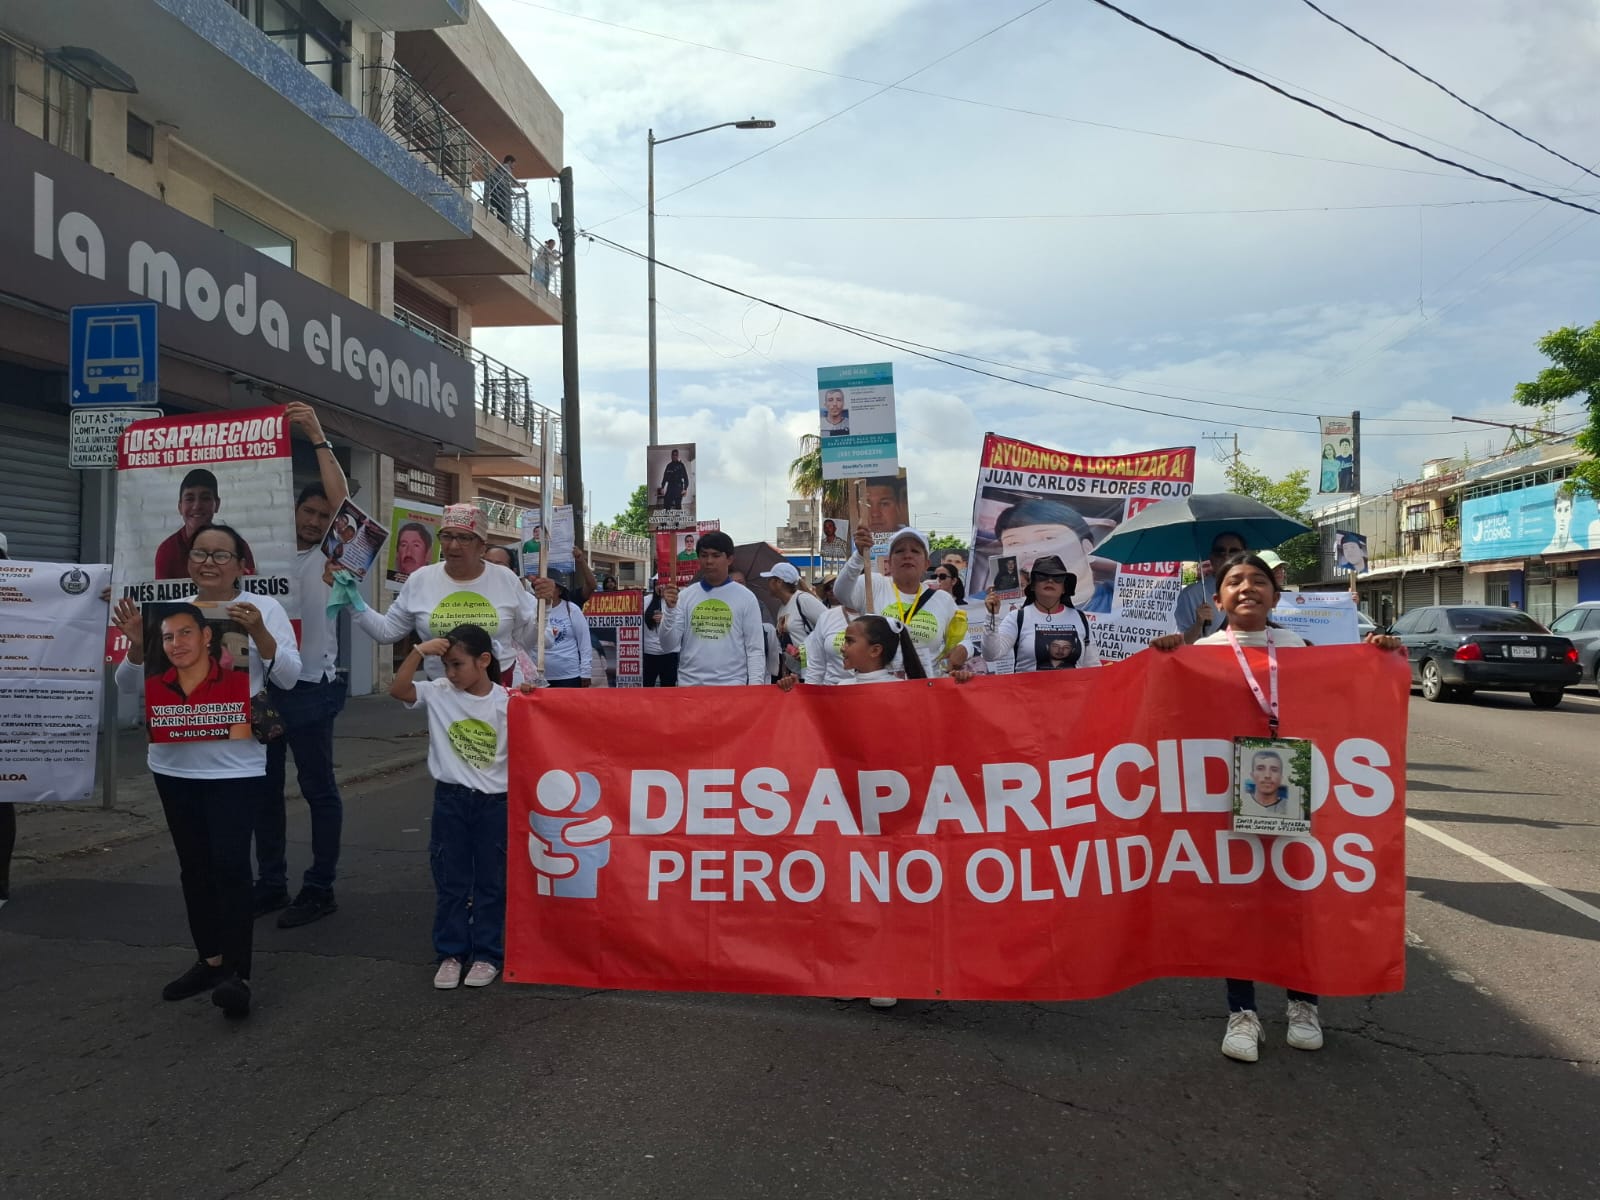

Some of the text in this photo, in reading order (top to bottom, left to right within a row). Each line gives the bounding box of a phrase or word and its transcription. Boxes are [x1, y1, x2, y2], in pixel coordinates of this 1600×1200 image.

[34, 171, 458, 418] la moda elegante
[123, 416, 283, 454] ¡DESAPARECIDO!
[128, 442, 276, 466] DESDE 16 DE ENERO DEL 2025
[990, 441, 1186, 477] ¡AYÚDANOS A LOCALIZAR A!
[985, 469, 1191, 497] JUAN CARLOS FLORES ROJO
[1483, 527, 1512, 541] COSMOS
[123, 584, 154, 601] INÉS
[1117, 577, 1125, 587] EL
[1137, 578, 1145, 588] 23
[1146, 580, 1154, 589] DE
[1155, 580, 1171, 590] JULIO
[1172, 581, 1180, 591] DE
[1119, 588, 1133, 598] 2025
[1134, 589, 1145, 599] FUE
[597, 595, 631, 612] LOCALIZAR
[1134, 600, 1146, 609] QUE
[1147, 601, 1155, 610] SE
[1157, 601, 1172, 611] TUVO
[599, 617, 623, 627] FLORES
[625, 616, 641, 627] ROJO
[152, 702, 244, 716] VICTOR JOHBANY
[151, 713, 247, 728] MARIN MELENDREZ
[169, 728, 229, 739] 04-JULIO-2024
[629, 737, 1395, 836] DESAPARECIDS
[648, 829, 1376, 904] PERO NO OLVIDADOS
